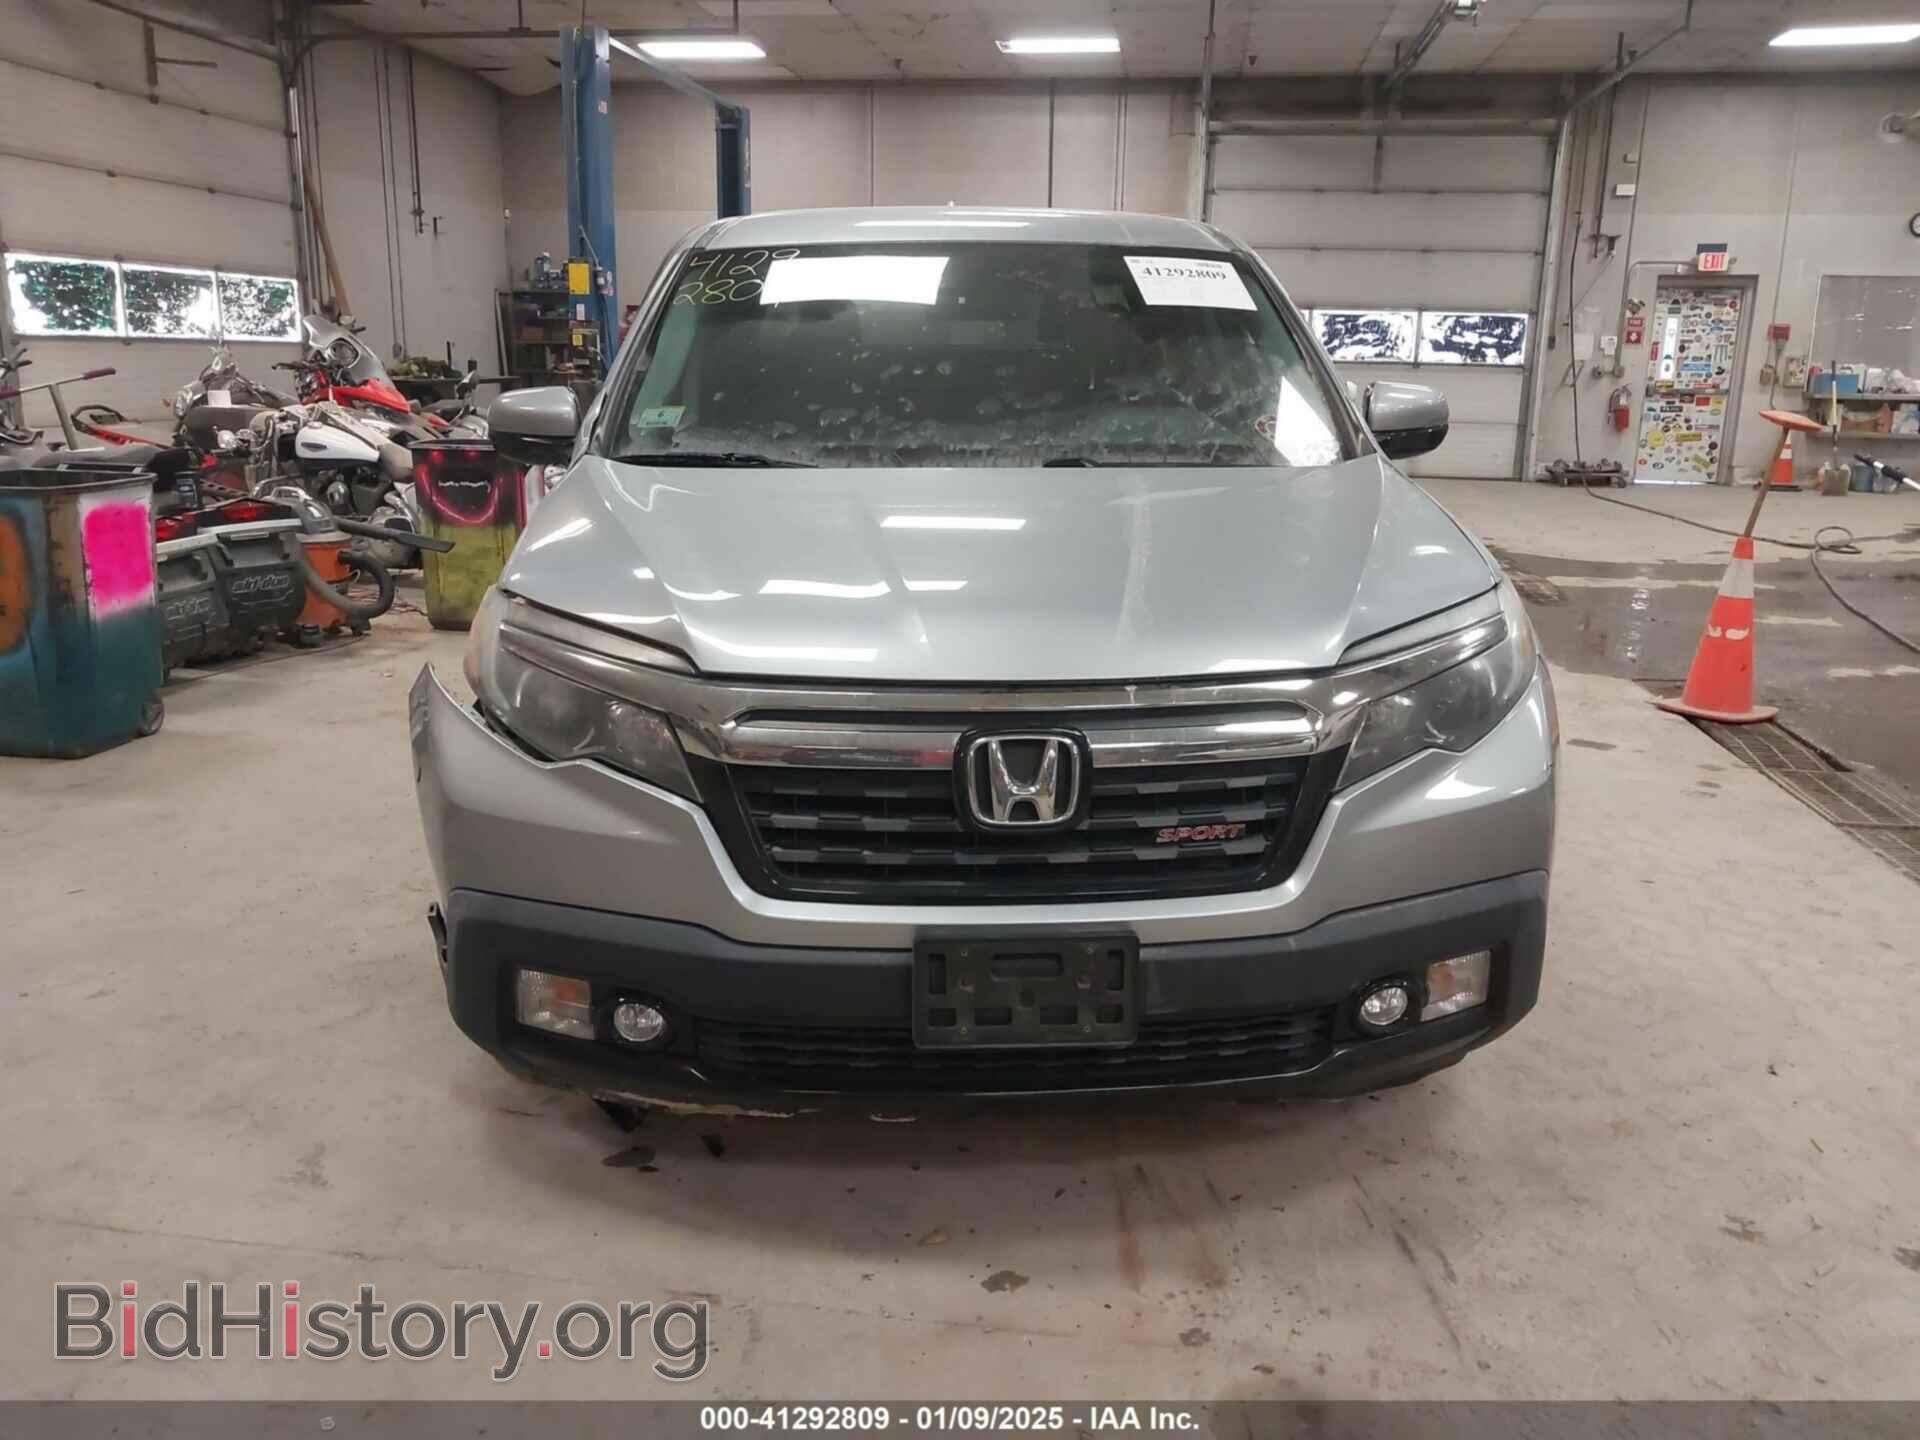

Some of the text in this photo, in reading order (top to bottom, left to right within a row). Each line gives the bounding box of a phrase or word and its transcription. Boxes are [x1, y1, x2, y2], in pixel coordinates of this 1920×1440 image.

[1703, 254, 1726, 270] EXIT
[672, 279, 779, 309] 280
[1156, 824, 1246, 843] SPORT
